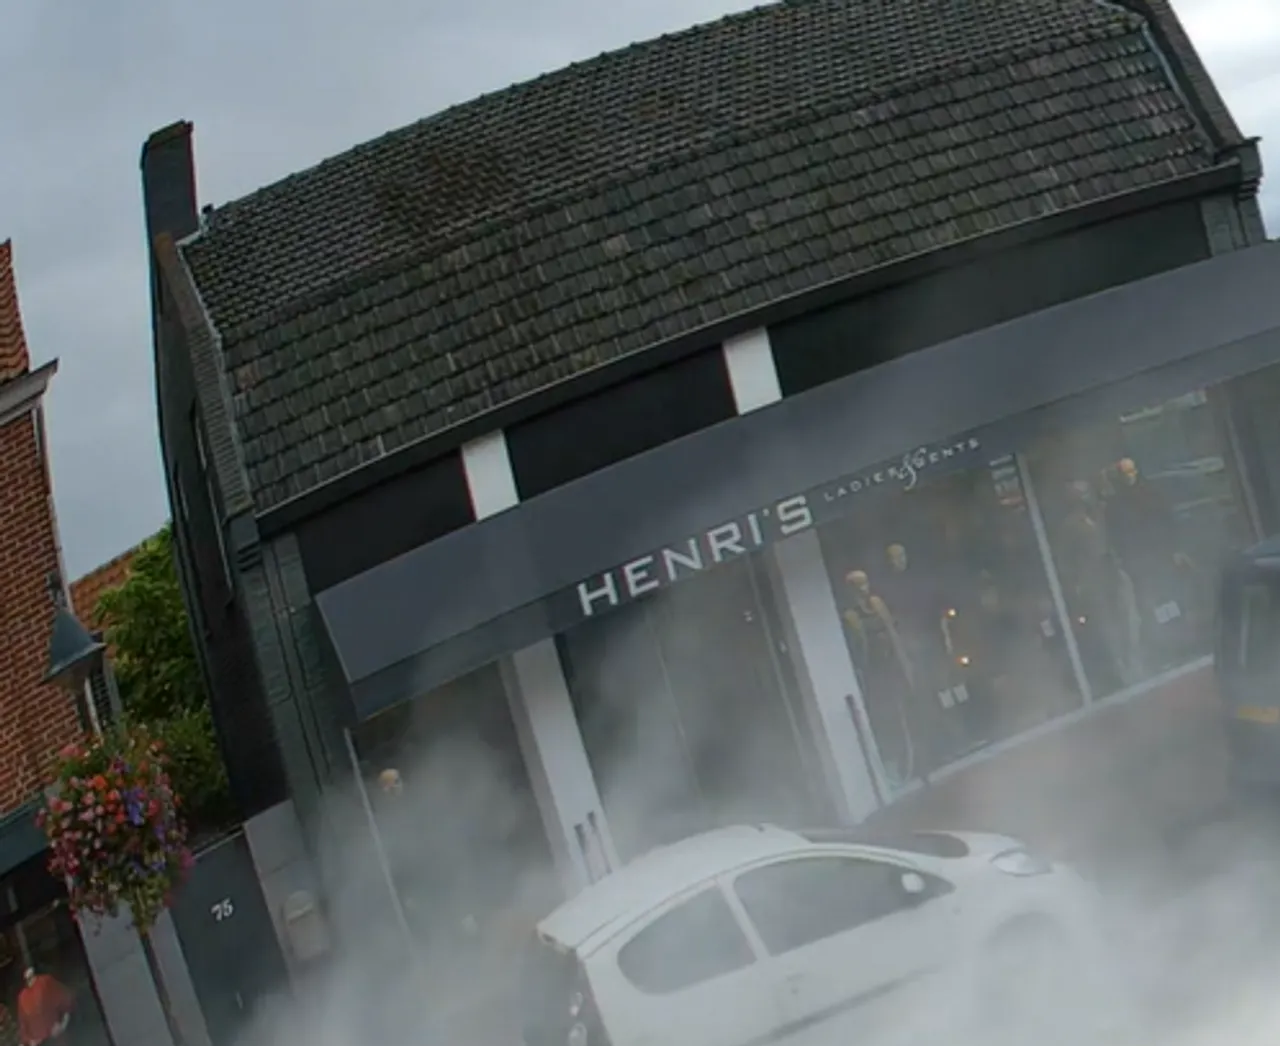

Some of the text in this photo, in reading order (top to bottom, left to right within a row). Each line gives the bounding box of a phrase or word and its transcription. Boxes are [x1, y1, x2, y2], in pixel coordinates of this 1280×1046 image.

[577, 495, 813, 617] HENRI'S
[824, 466, 898, 502] LADIES
[210, 898, 234, 921] 75
